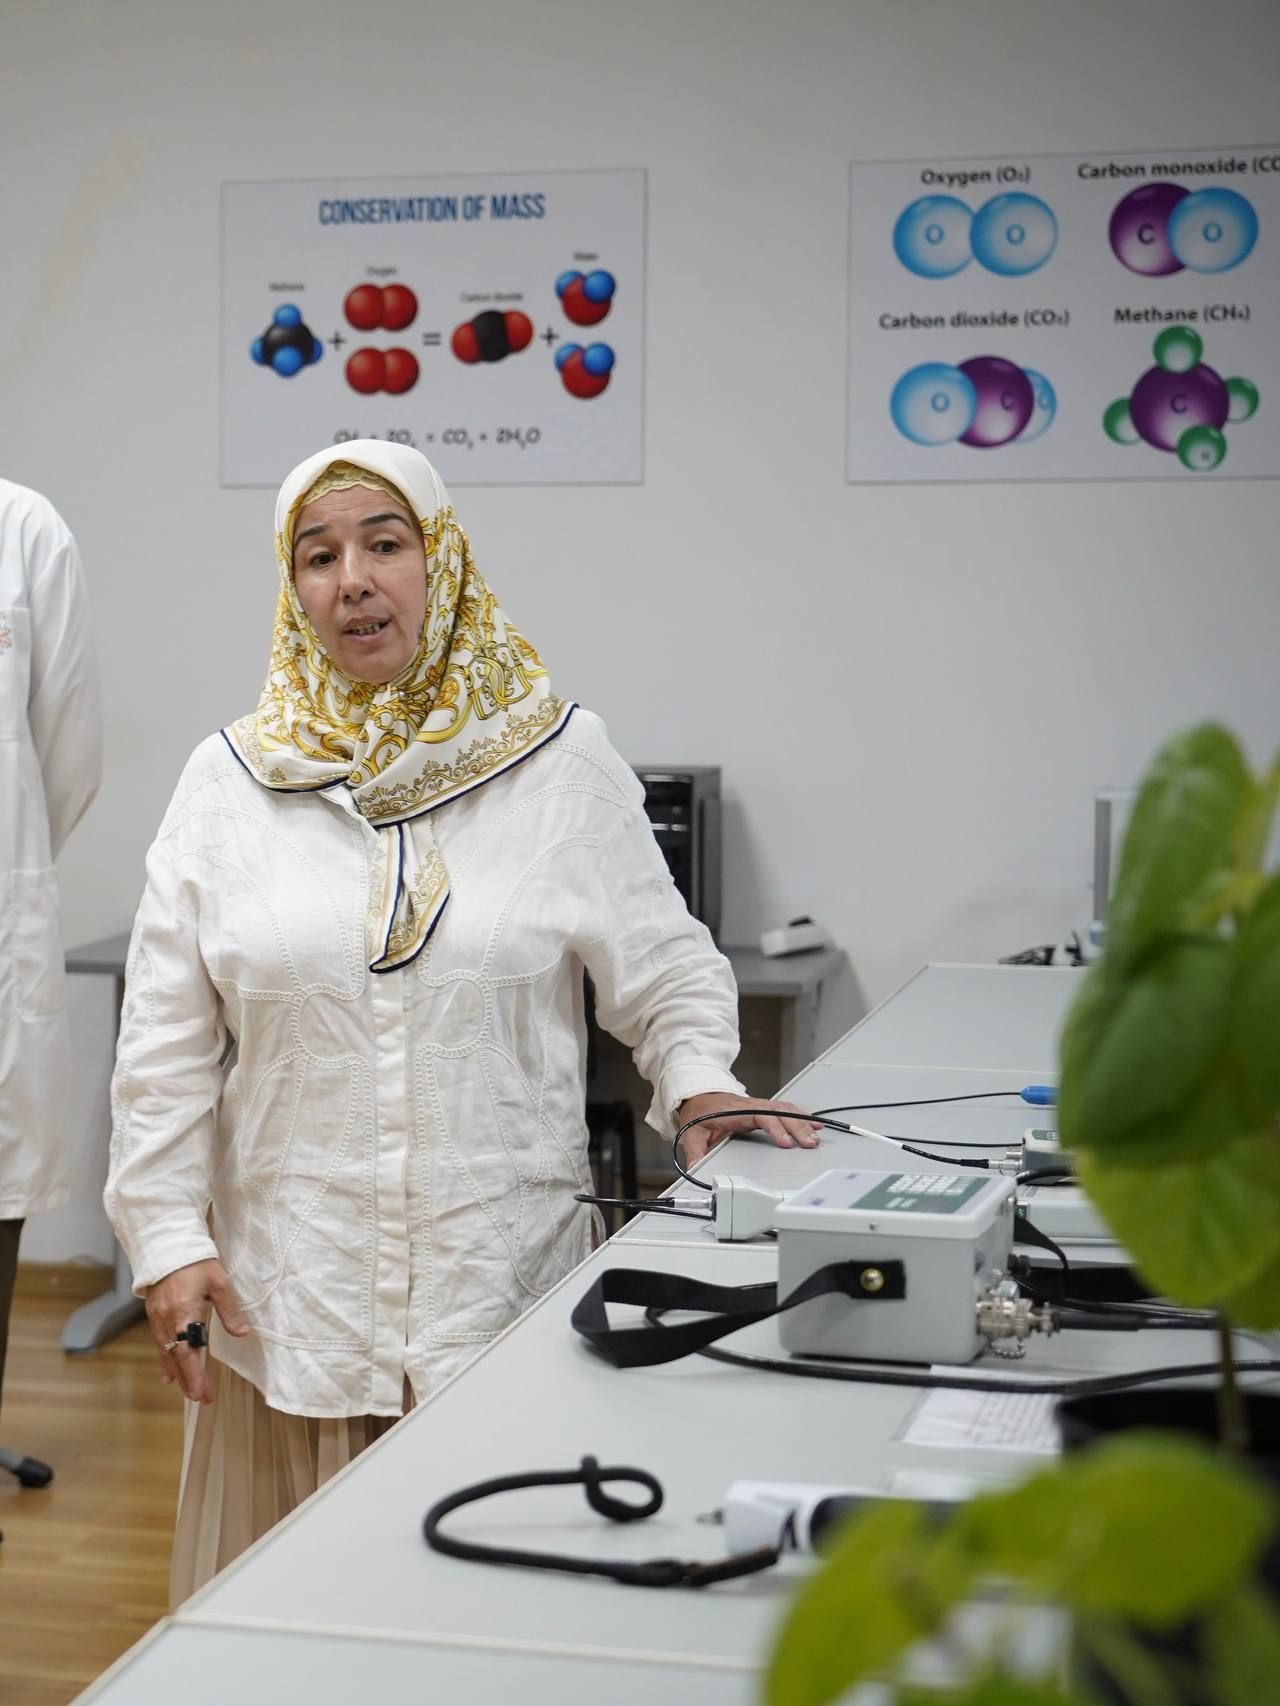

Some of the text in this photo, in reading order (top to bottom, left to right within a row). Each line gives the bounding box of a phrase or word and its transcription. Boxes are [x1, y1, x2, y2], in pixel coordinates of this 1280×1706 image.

[920, 168, 991, 187] Oxygen
[1078, 161, 1146, 179] Carbon
[1151, 156, 1248, 175] monoxide
[319, 193, 545, 225] CONSERVATION OF MASS
[925, 224, 1025, 245] O O
[1137, 221, 1223, 245] C O
[878, 312, 946, 330] Carbon
[950, 310, 1019, 329] dioxide
[1114, 305, 1198, 323] Methane
[931, 392, 949, 413] O
[1170, 393, 1188, 413] C
